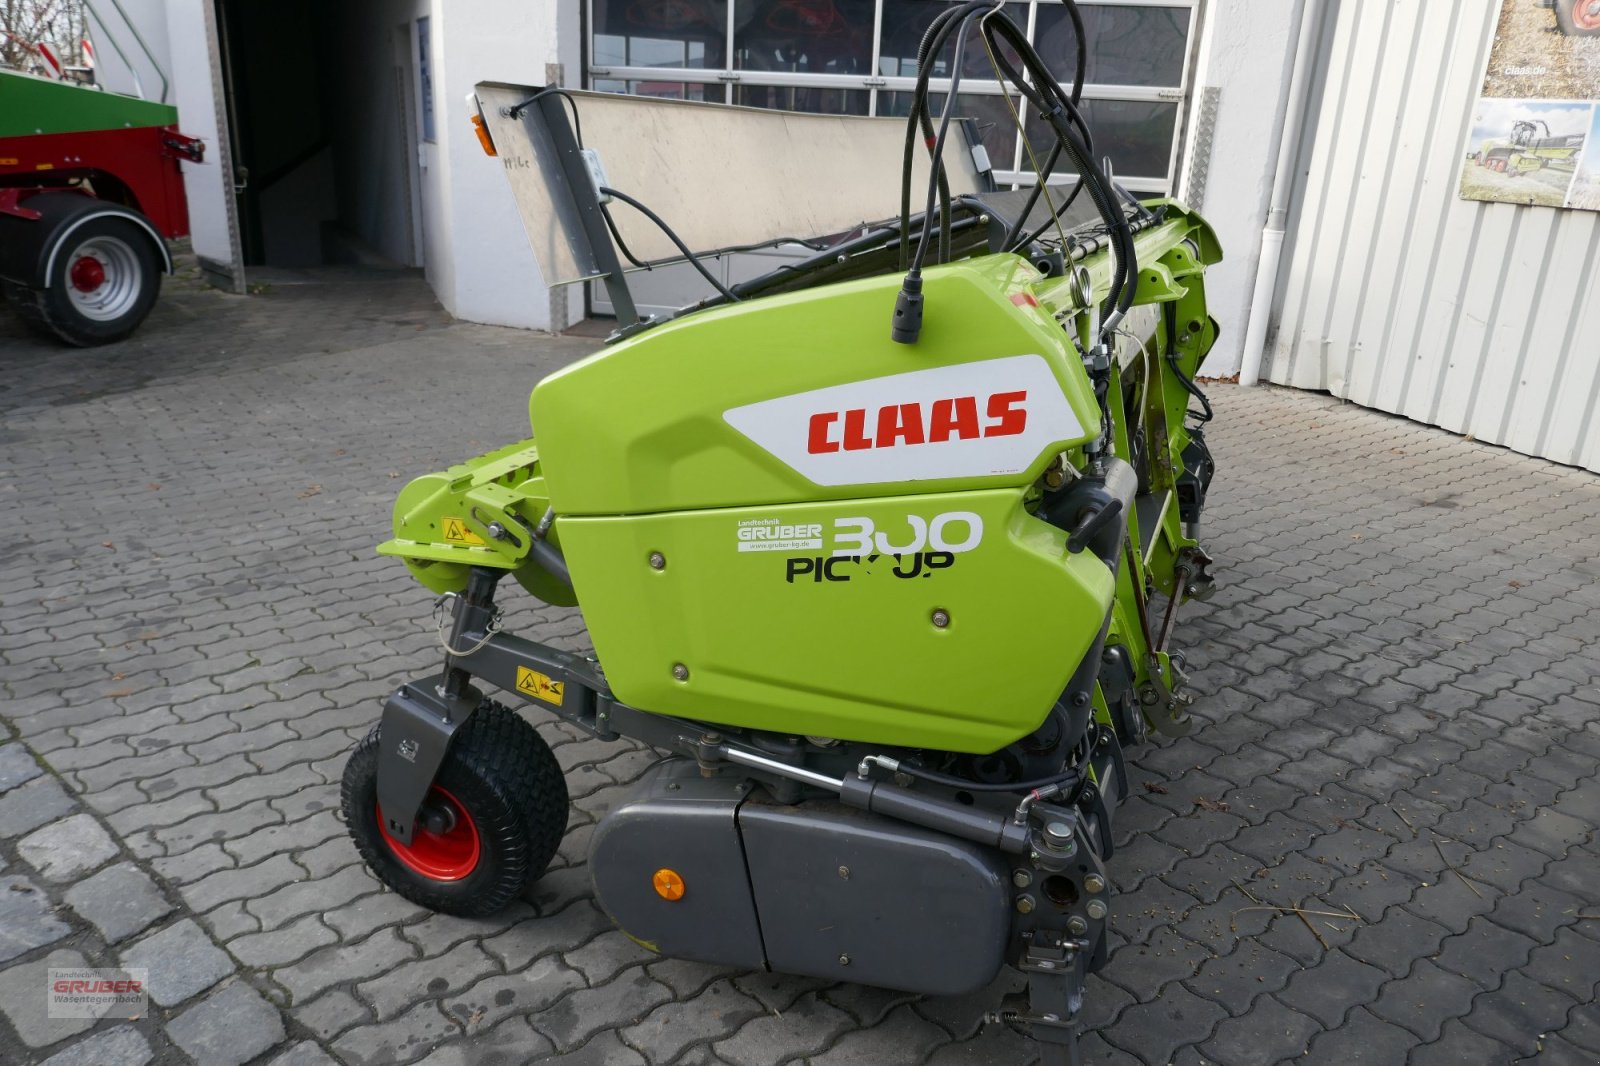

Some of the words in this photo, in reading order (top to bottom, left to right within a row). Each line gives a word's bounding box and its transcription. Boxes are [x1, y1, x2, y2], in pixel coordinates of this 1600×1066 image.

[1504, 65, 1546, 75] claas.de
[807, 390, 1027, 455] CLAAS
[737, 524, 822, 540] GRUBER
[749, 541, 810, 549] www.gruber-kg.de
